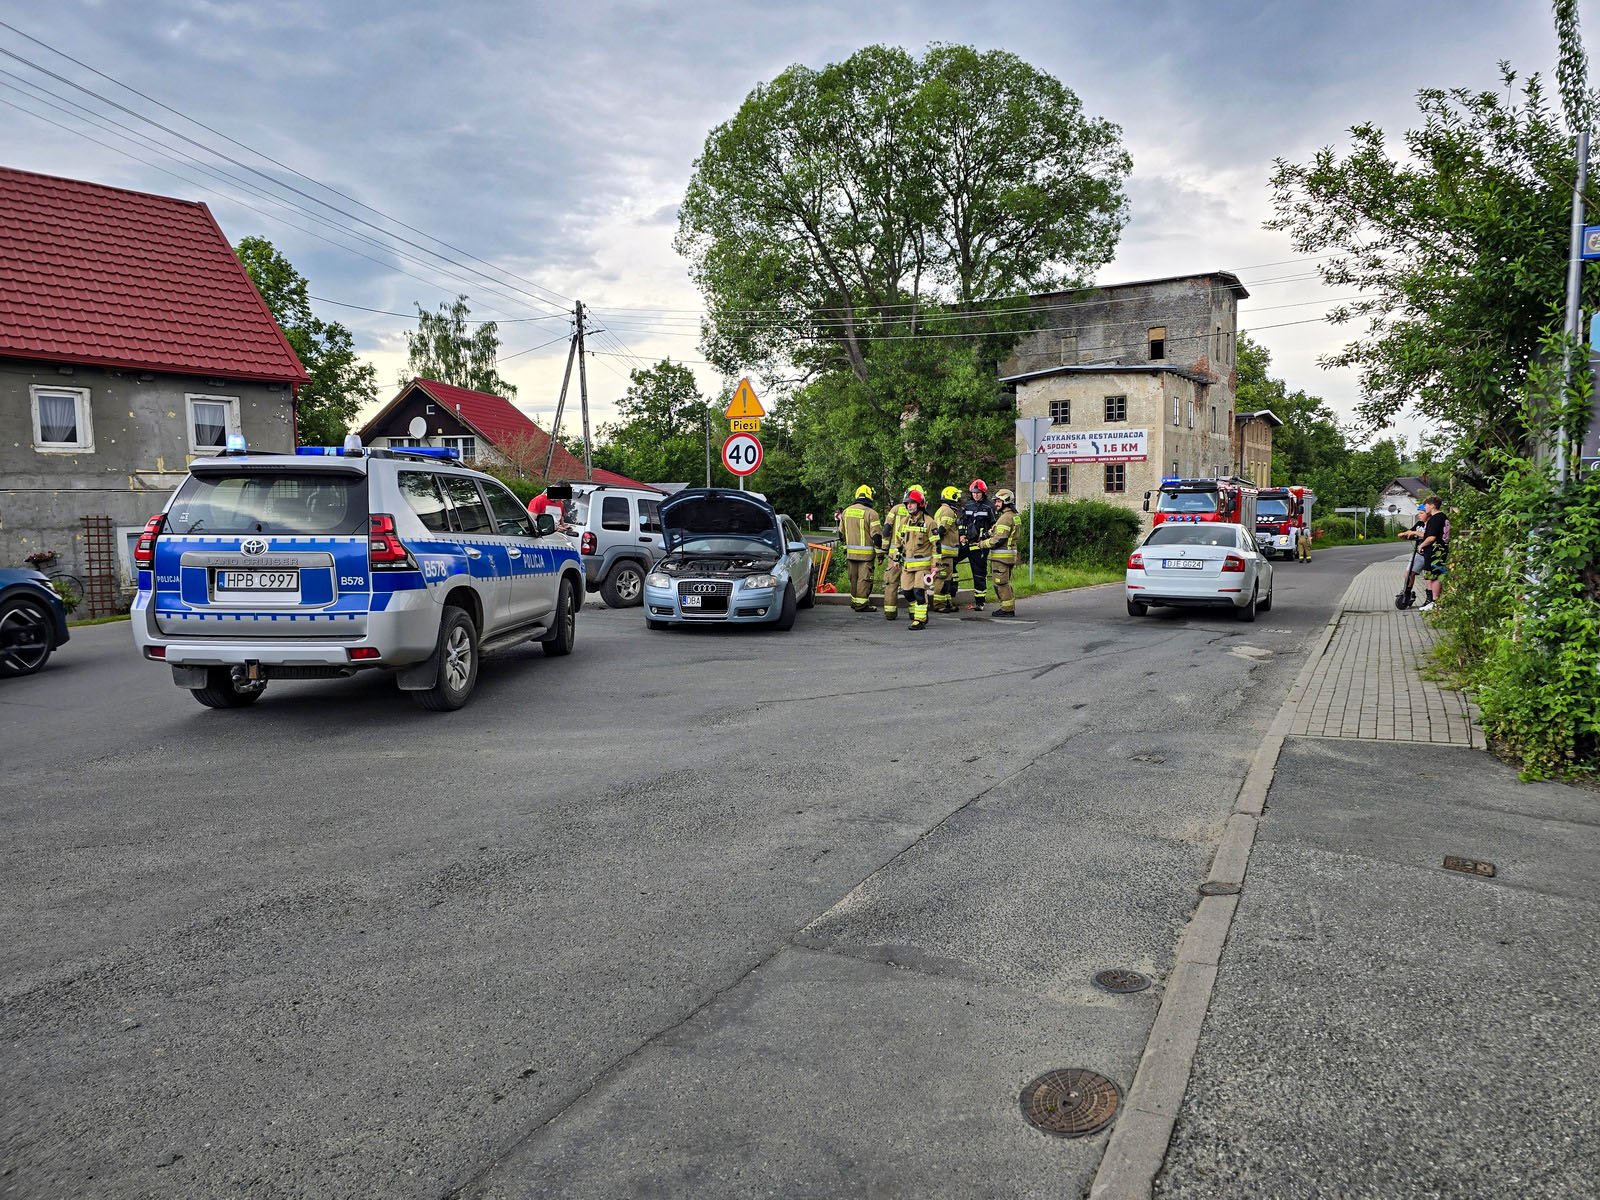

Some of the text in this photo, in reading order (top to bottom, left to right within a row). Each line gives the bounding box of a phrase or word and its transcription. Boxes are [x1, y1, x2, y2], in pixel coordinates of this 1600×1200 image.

[733, 420, 757, 430] Piesi
[1088, 431, 1144, 440] RESTAURACJA
[1047, 441, 1078, 450] SPOON'S
[1103, 442, 1138, 453] 1.6 KM
[728, 444, 757, 465] 40
[207, 558, 299, 566] LAND CRUISER
[523, 553, 546, 569] POLICJA
[423, 560, 448, 578] B578
[156, 575, 180, 583] POLICJA
[227, 573, 294, 588] HPB C997
[340, 576, 365, 586] B578
